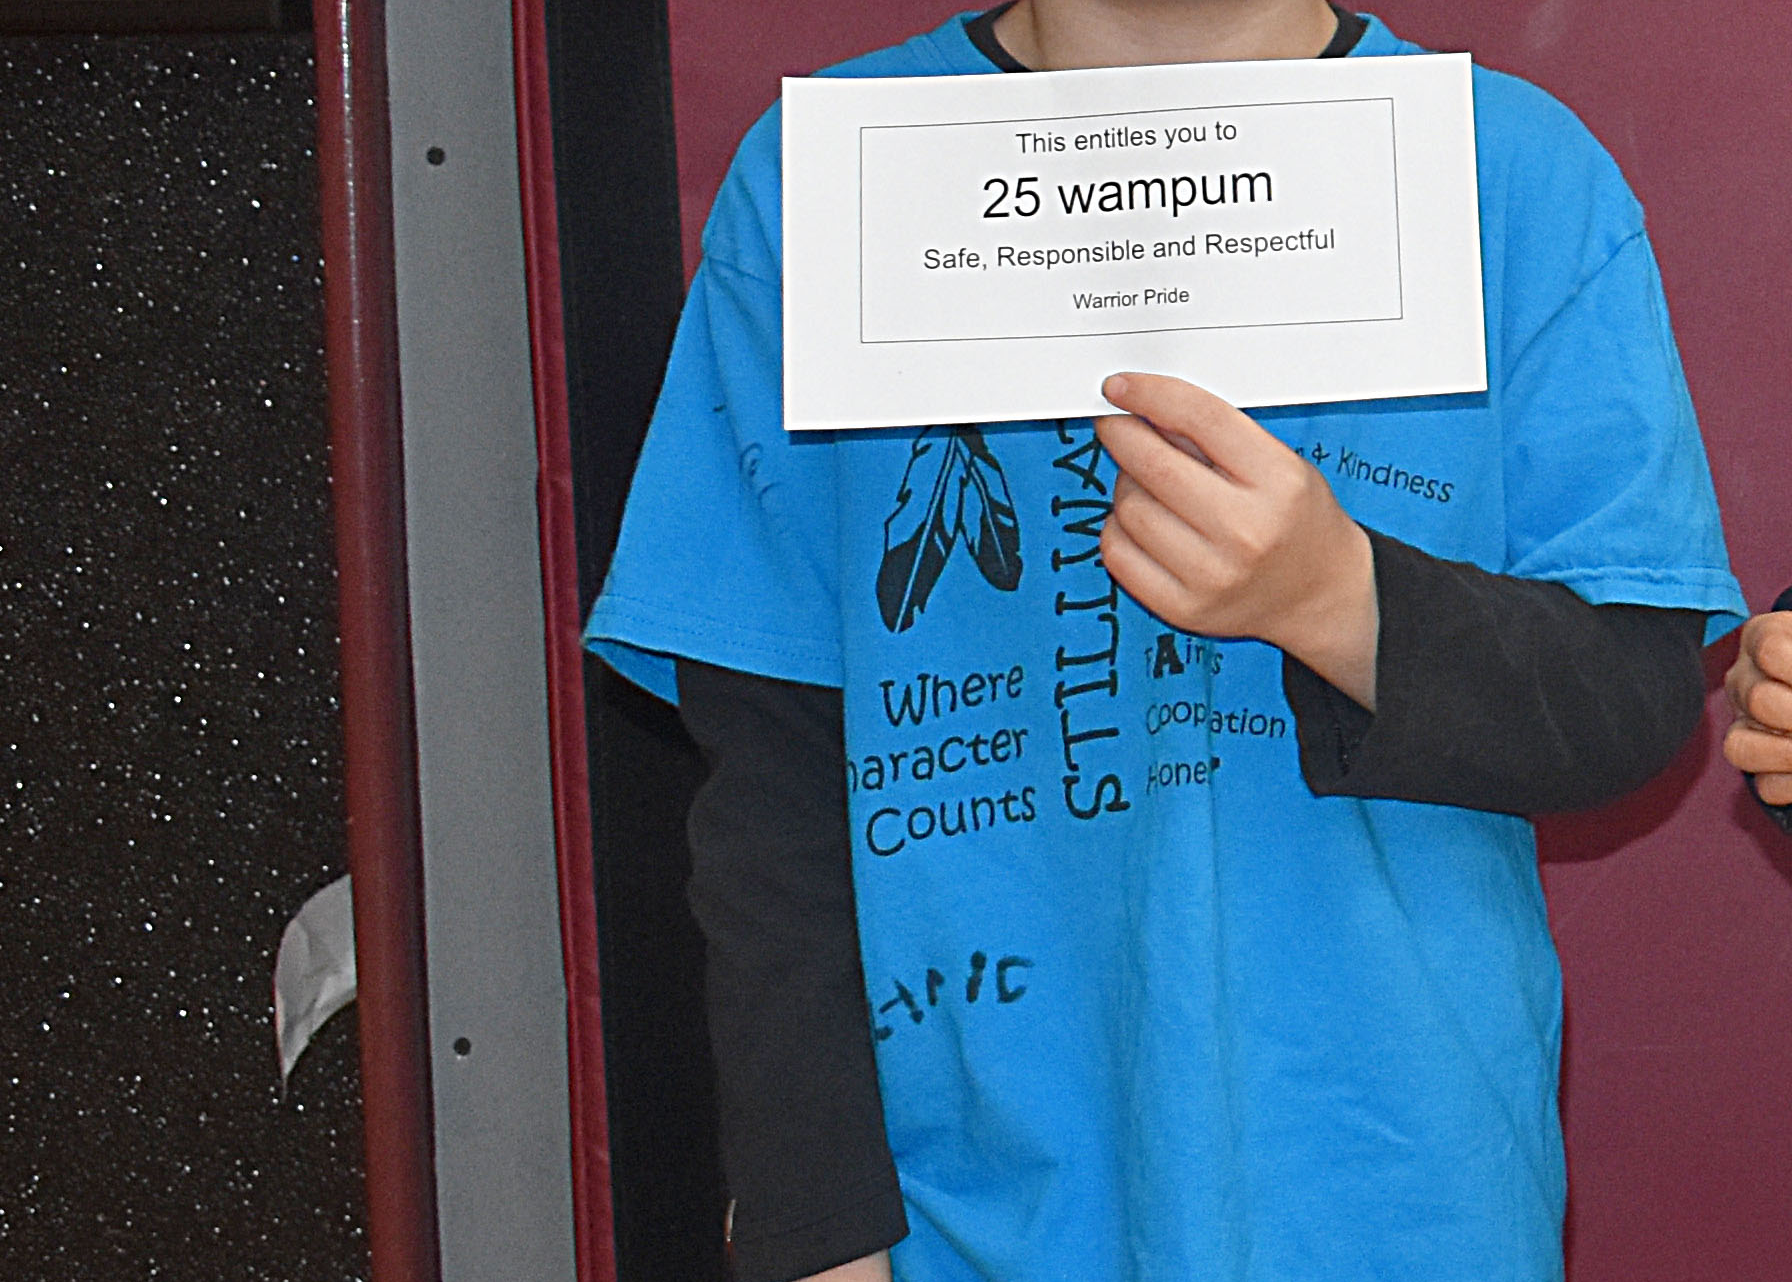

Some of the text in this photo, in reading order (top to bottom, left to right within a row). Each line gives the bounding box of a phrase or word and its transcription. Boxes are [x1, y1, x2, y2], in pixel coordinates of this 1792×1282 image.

[1015, 121, 1237, 154] This entitles you to
[982, 171, 1273, 219] 25 wampum
[924, 228, 1335, 270] Safe, Responsible and Respectful
[1072, 287, 1190, 310] Warrior Pride
[1335, 445, 1456, 504] Kindness
[1049, 420, 1131, 820] STILLWA
[879, 664, 1024, 728] Where
[866, 784, 1037, 857] Counts
